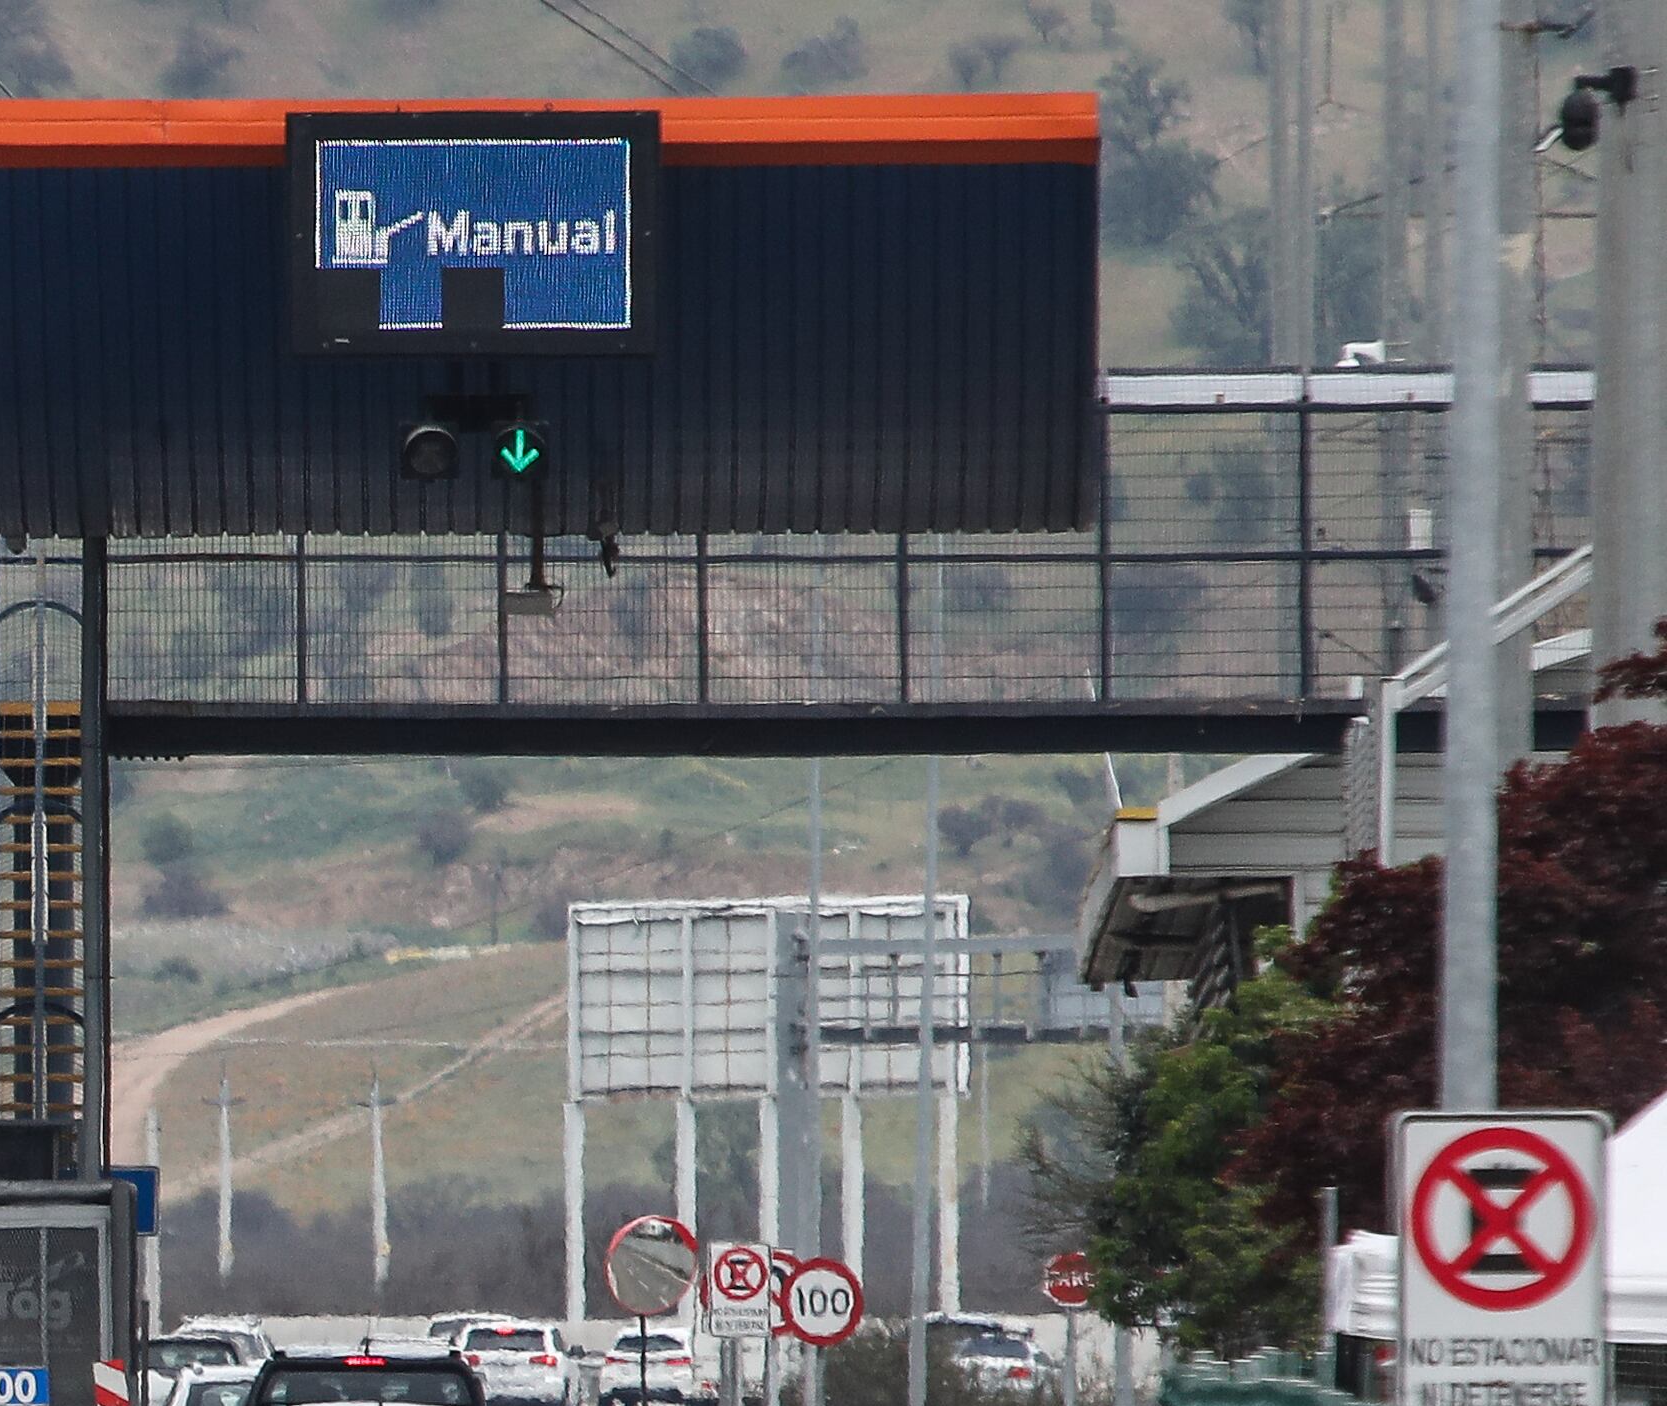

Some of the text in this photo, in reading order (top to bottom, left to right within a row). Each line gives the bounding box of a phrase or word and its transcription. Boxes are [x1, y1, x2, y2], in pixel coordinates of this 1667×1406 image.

[427, 209, 616, 256] Manual
[796, 1286, 851, 1316] 100
[1410, 1337, 1600, 1366] NO ESTACIONAR
